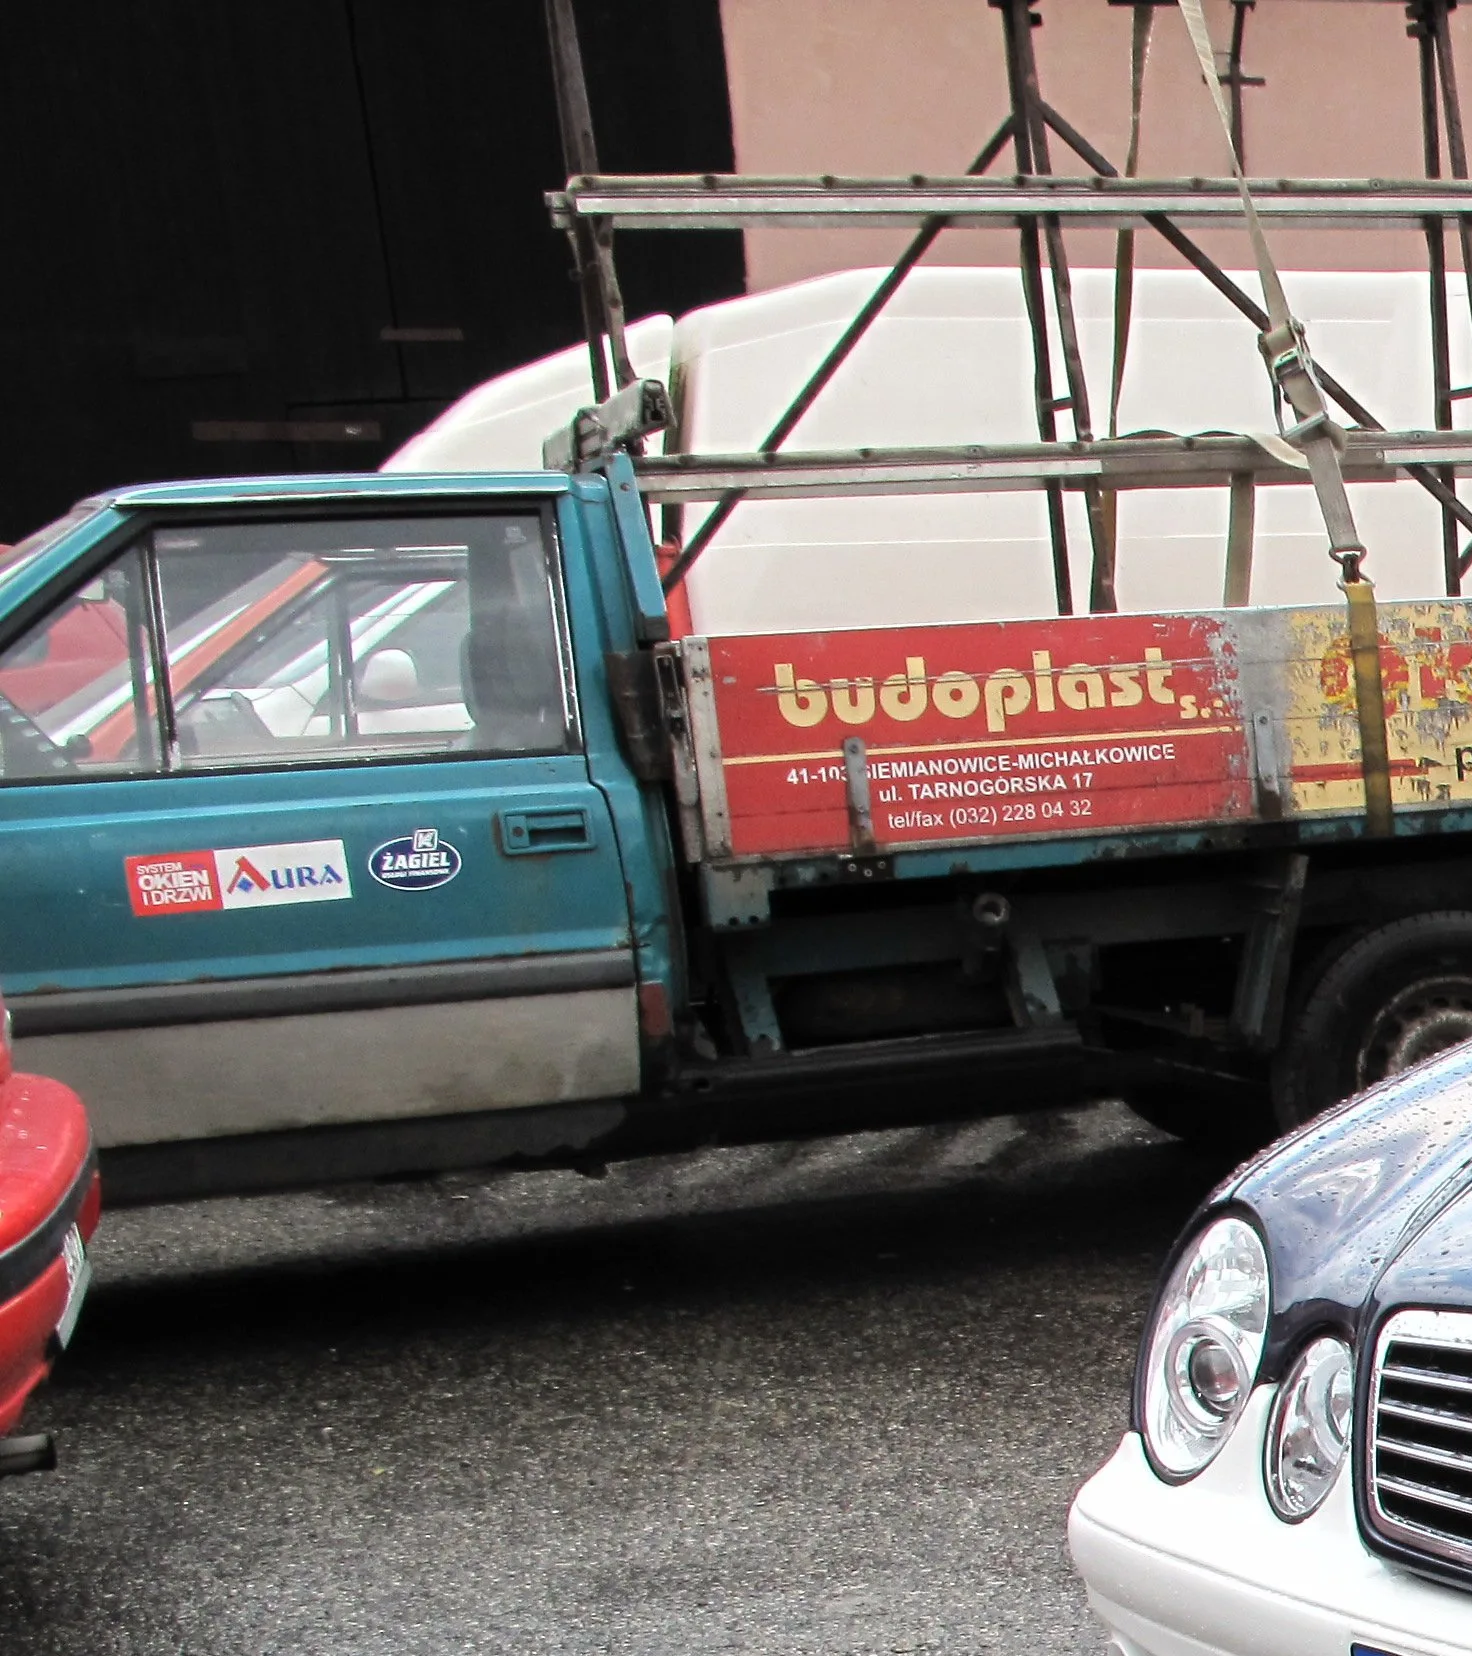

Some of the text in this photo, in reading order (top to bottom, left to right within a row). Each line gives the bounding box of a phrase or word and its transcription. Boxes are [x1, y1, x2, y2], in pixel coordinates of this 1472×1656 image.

[774, 647, 1175, 733] budoplast
[879, 772, 1093, 802] ul. TARNOGÓRSKA 17
[888, 799, 1092, 829] tel/fax (032) 228 04 32
[136, 861, 183, 875] SYSTEM
[382, 852, 451, 871] ŻAGIEL
[138, 869, 210, 892] OKIEN
[152, 886, 213, 906] DRZWI
